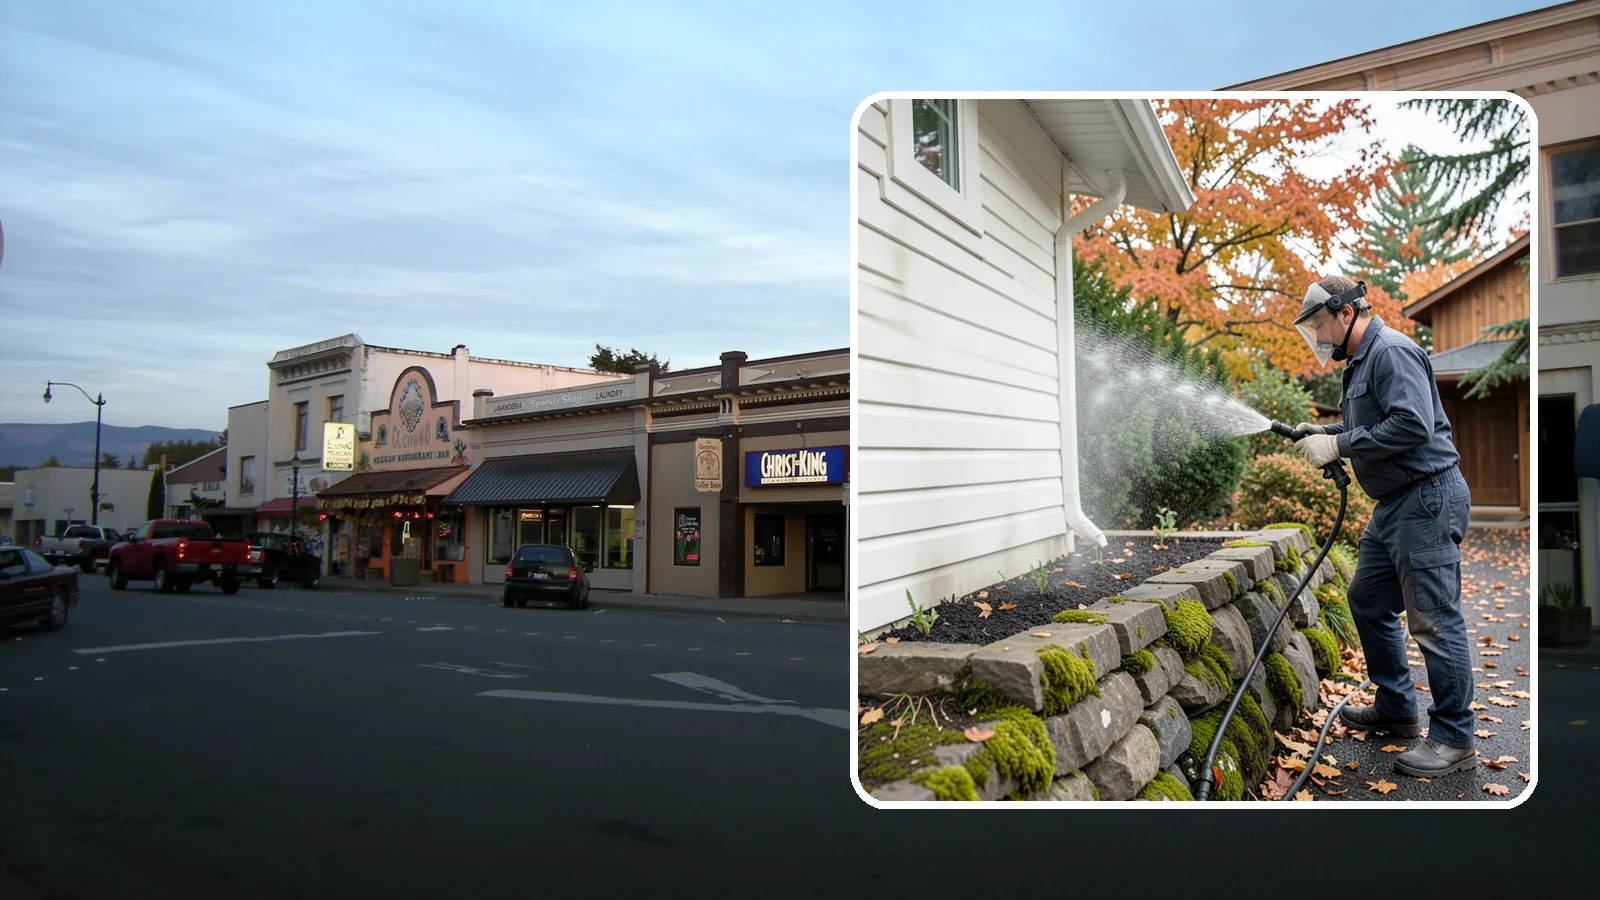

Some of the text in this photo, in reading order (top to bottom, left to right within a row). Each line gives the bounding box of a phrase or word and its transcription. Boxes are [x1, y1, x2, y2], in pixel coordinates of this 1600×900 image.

[531, 394, 583, 408] Sparkle Shop
[596, 389, 623, 399] LAUNDRY
[493, 402, 522, 412] LAVANDERIA
[374, 455, 396, 464] MEXICAN
[398, 451, 434, 463] RESTAURANT
[437, 450, 450, 459] BAR
[761, 450, 827, 477] CHRIST KING
